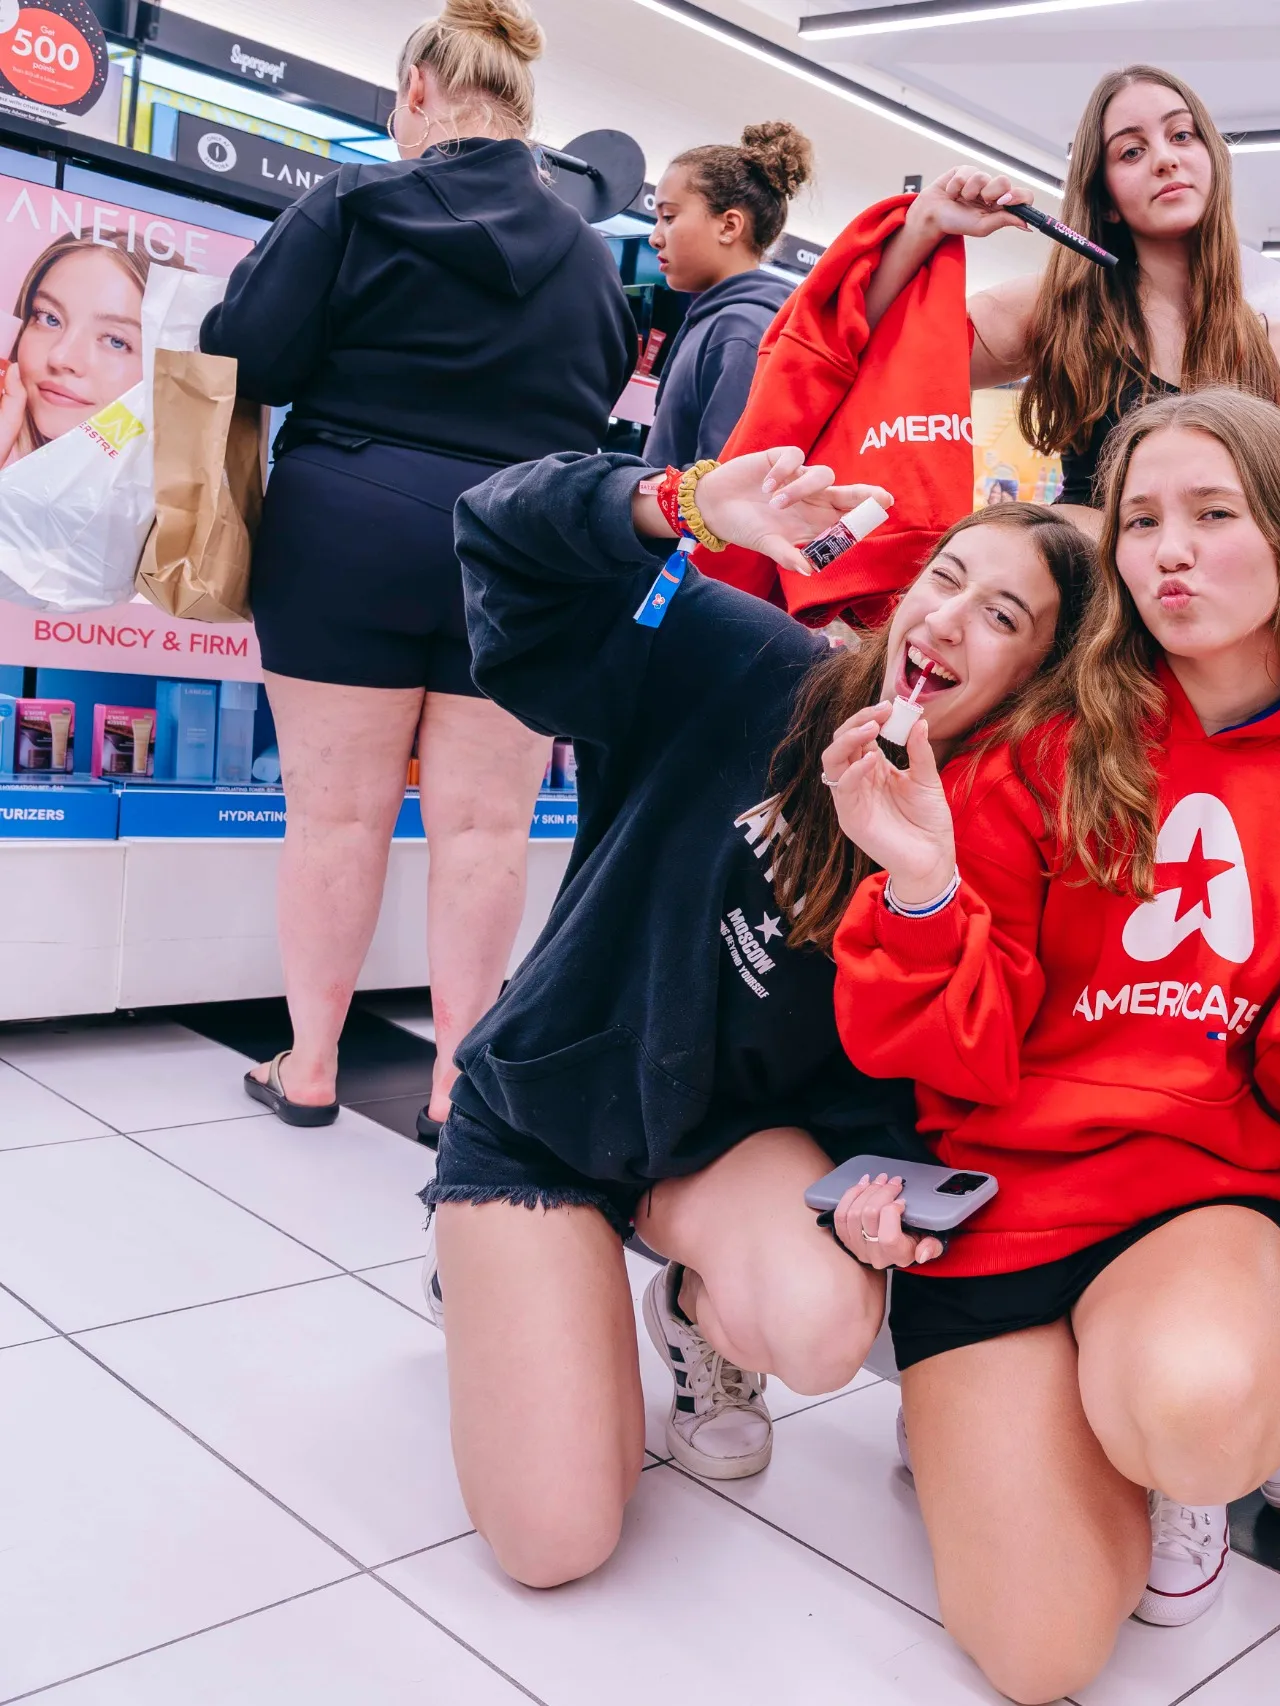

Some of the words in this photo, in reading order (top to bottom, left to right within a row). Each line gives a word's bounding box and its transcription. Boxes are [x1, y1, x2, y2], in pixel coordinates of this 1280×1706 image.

[11, 28, 79, 71] 500
[40, 25, 55, 36] Get
[34, 619, 155, 649] BOUNCY
[162, 631, 181, 652] &
[190, 633, 248, 657] FIRM
[542, 814, 565, 825] SKIN
[727, 907, 776, 975] MOSCOW
[725, 931, 742, 967] BEYOND
[739, 965, 770, 999] YOURSELF
